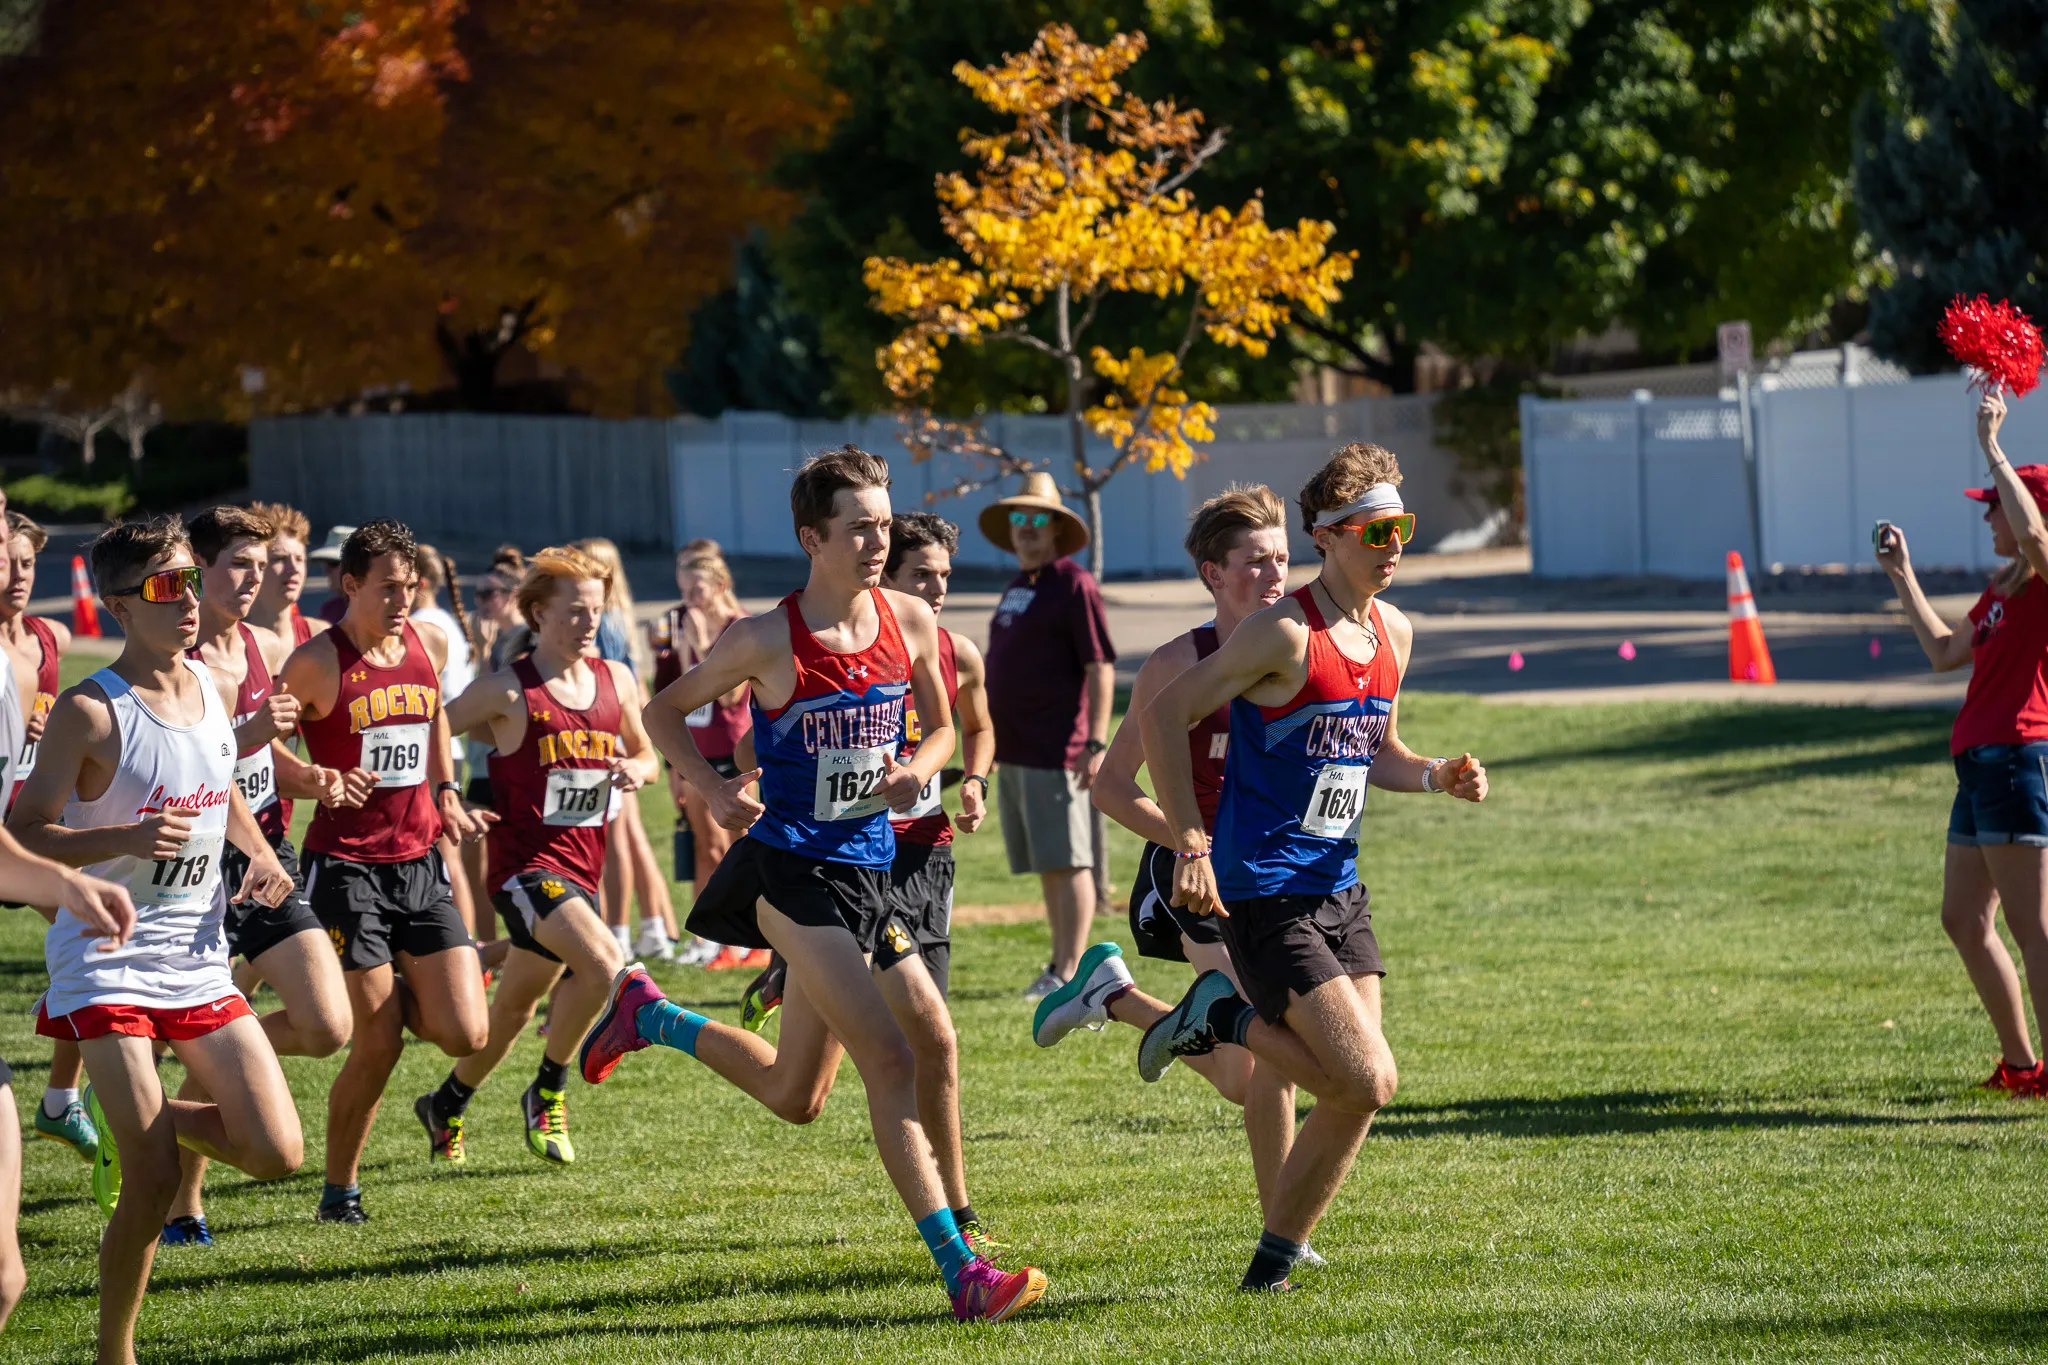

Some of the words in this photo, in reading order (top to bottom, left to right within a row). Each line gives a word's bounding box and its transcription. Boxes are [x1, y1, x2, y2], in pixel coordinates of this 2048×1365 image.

[349, 684, 437, 734] ROCKY
[802, 695, 904, 753] CENTAURU
[373, 732, 389, 740] HAL
[538, 729, 617, 767] ROCKY
[369, 743, 420, 772] 1769
[832, 756, 852, 764] HAL
[236, 766, 269, 800] 699
[1328, 770, 1344, 781] HAL
[556, 787, 599, 812] 1773
[1318, 787, 1358, 819] 1624
[152, 854, 209, 887] 1713
